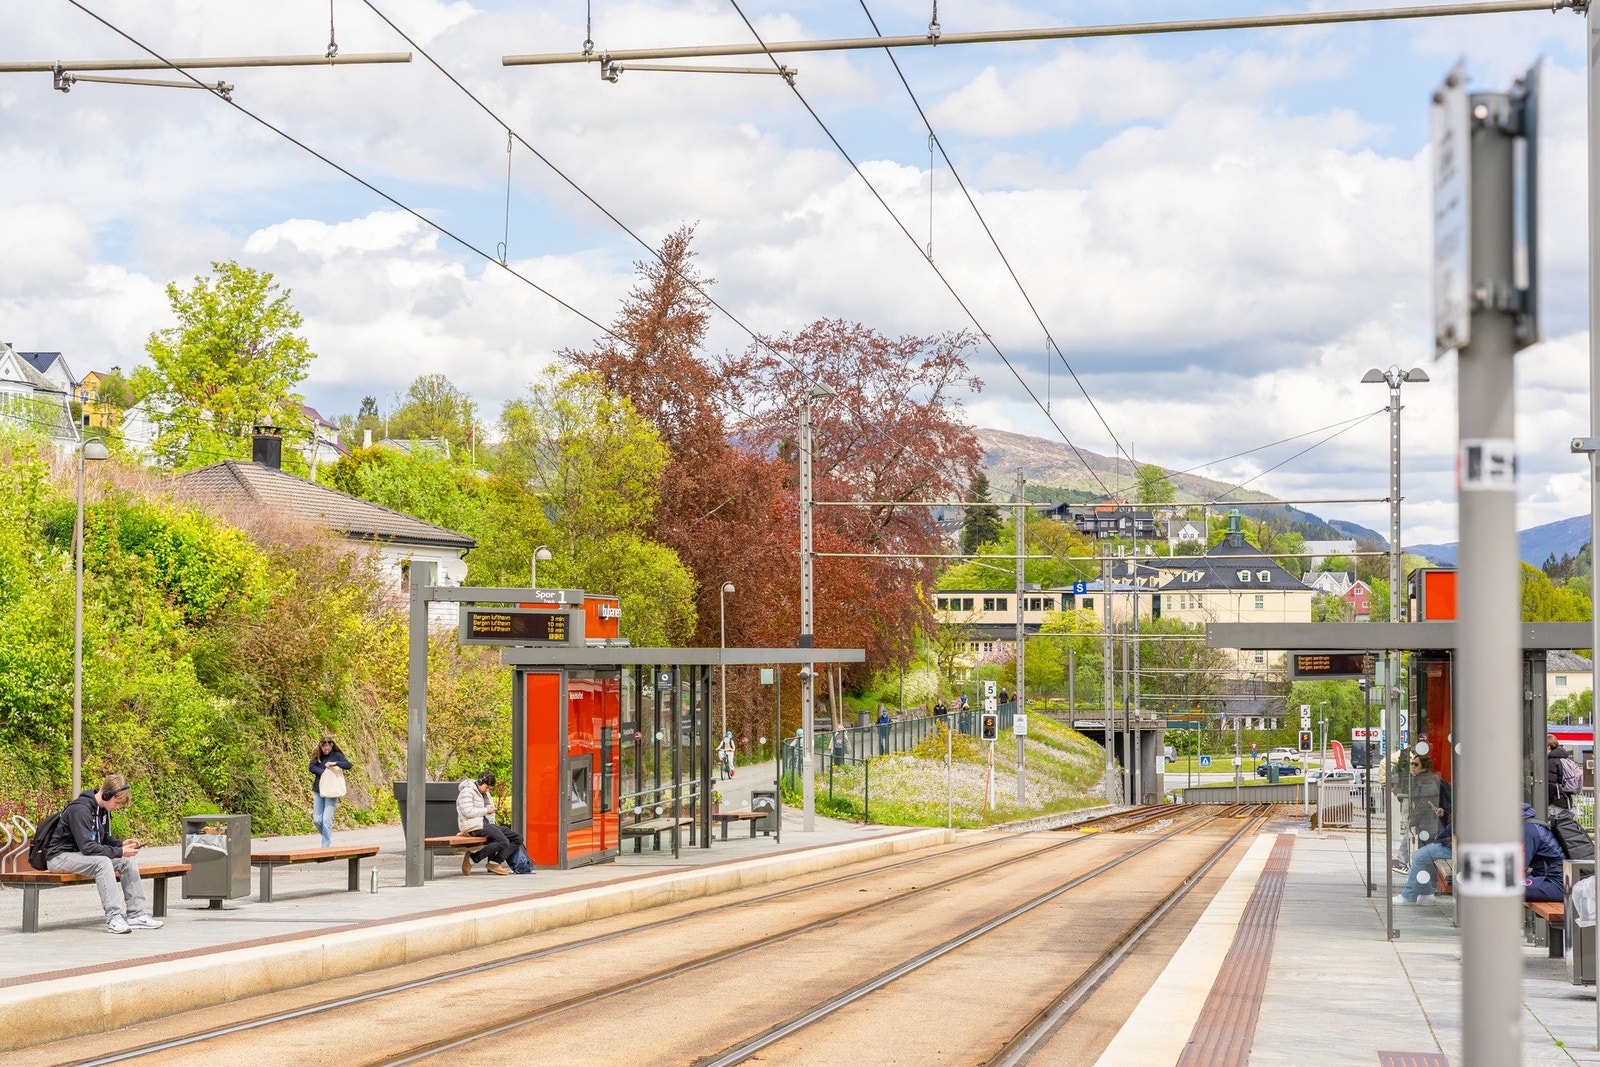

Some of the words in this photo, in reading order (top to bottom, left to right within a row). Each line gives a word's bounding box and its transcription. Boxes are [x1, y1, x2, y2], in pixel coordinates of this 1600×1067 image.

[1076, 583, 1084, 593] S
[535, 590, 556, 600] Spor
[558, 591, 567, 604] 1
[987, 686, 994, 694] 5
